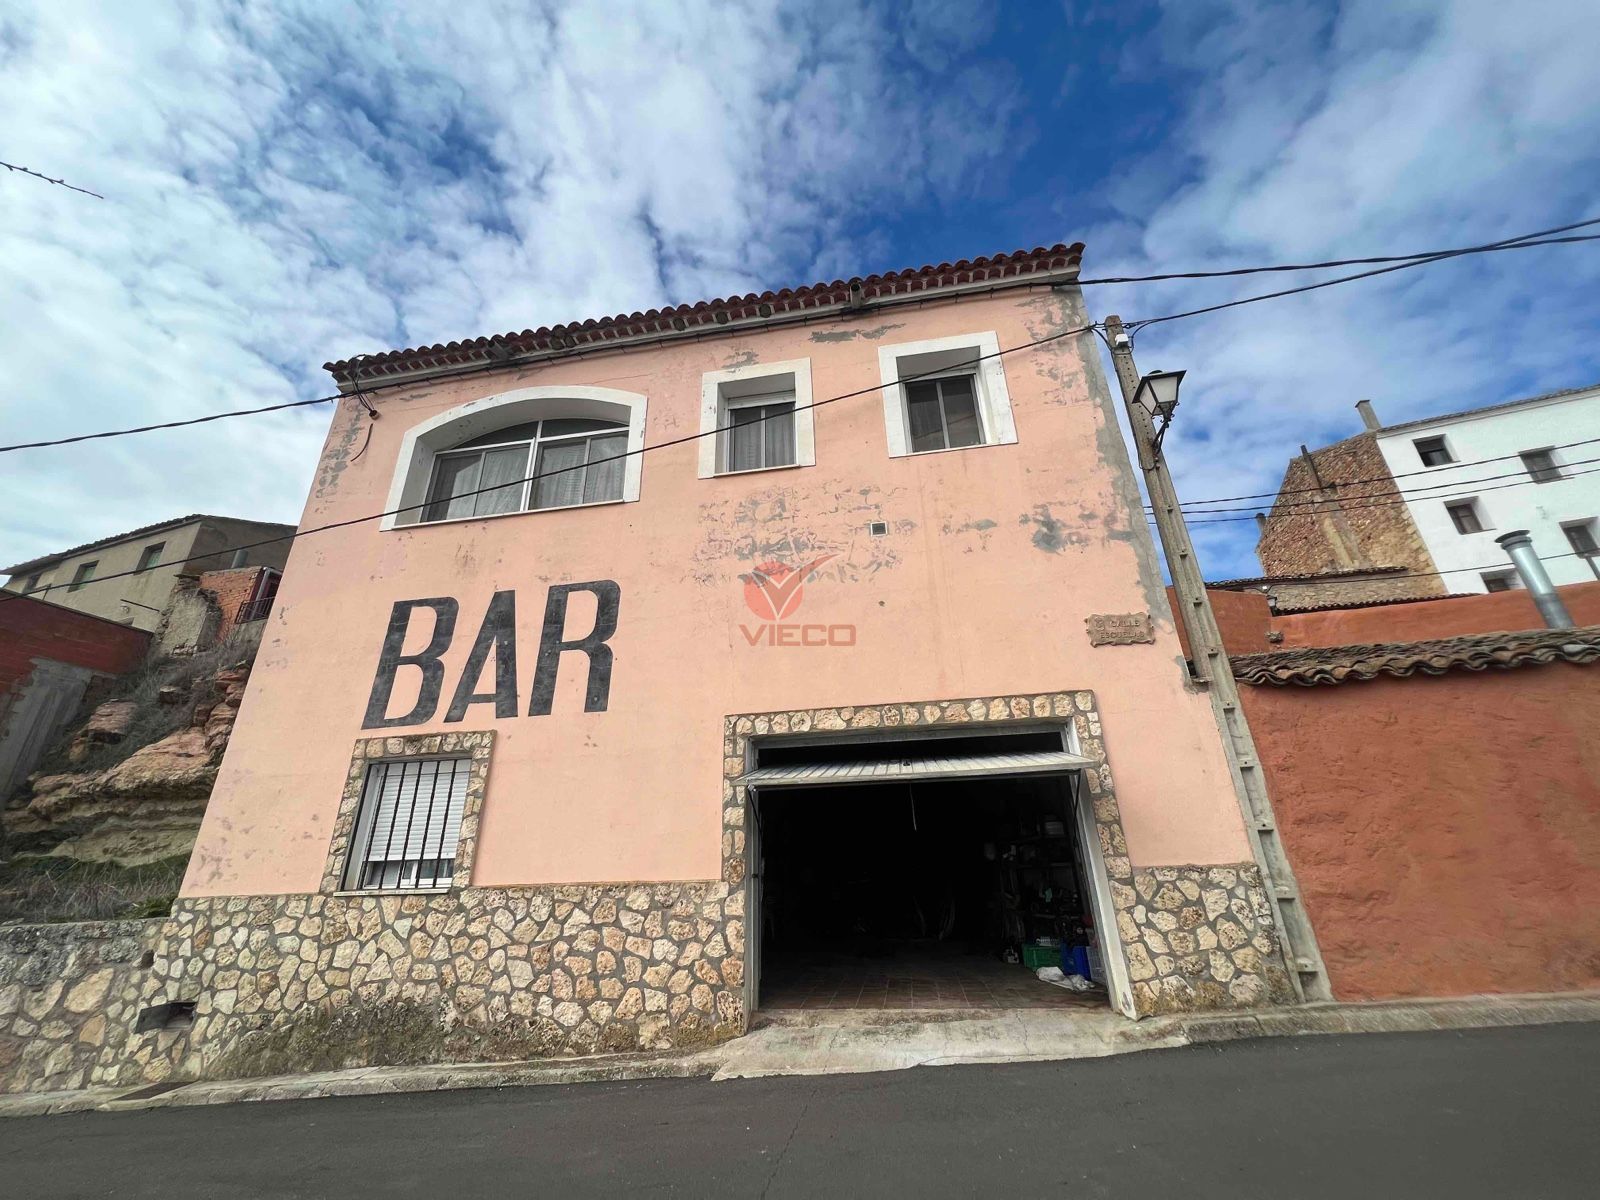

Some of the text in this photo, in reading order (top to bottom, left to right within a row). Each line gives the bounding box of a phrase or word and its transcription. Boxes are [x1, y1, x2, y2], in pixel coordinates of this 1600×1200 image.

[1109, 619, 1141, 628] CALLE
[1100, 630, 1145, 639] ESCUELAS
[361, 579, 621, 730] BAR
